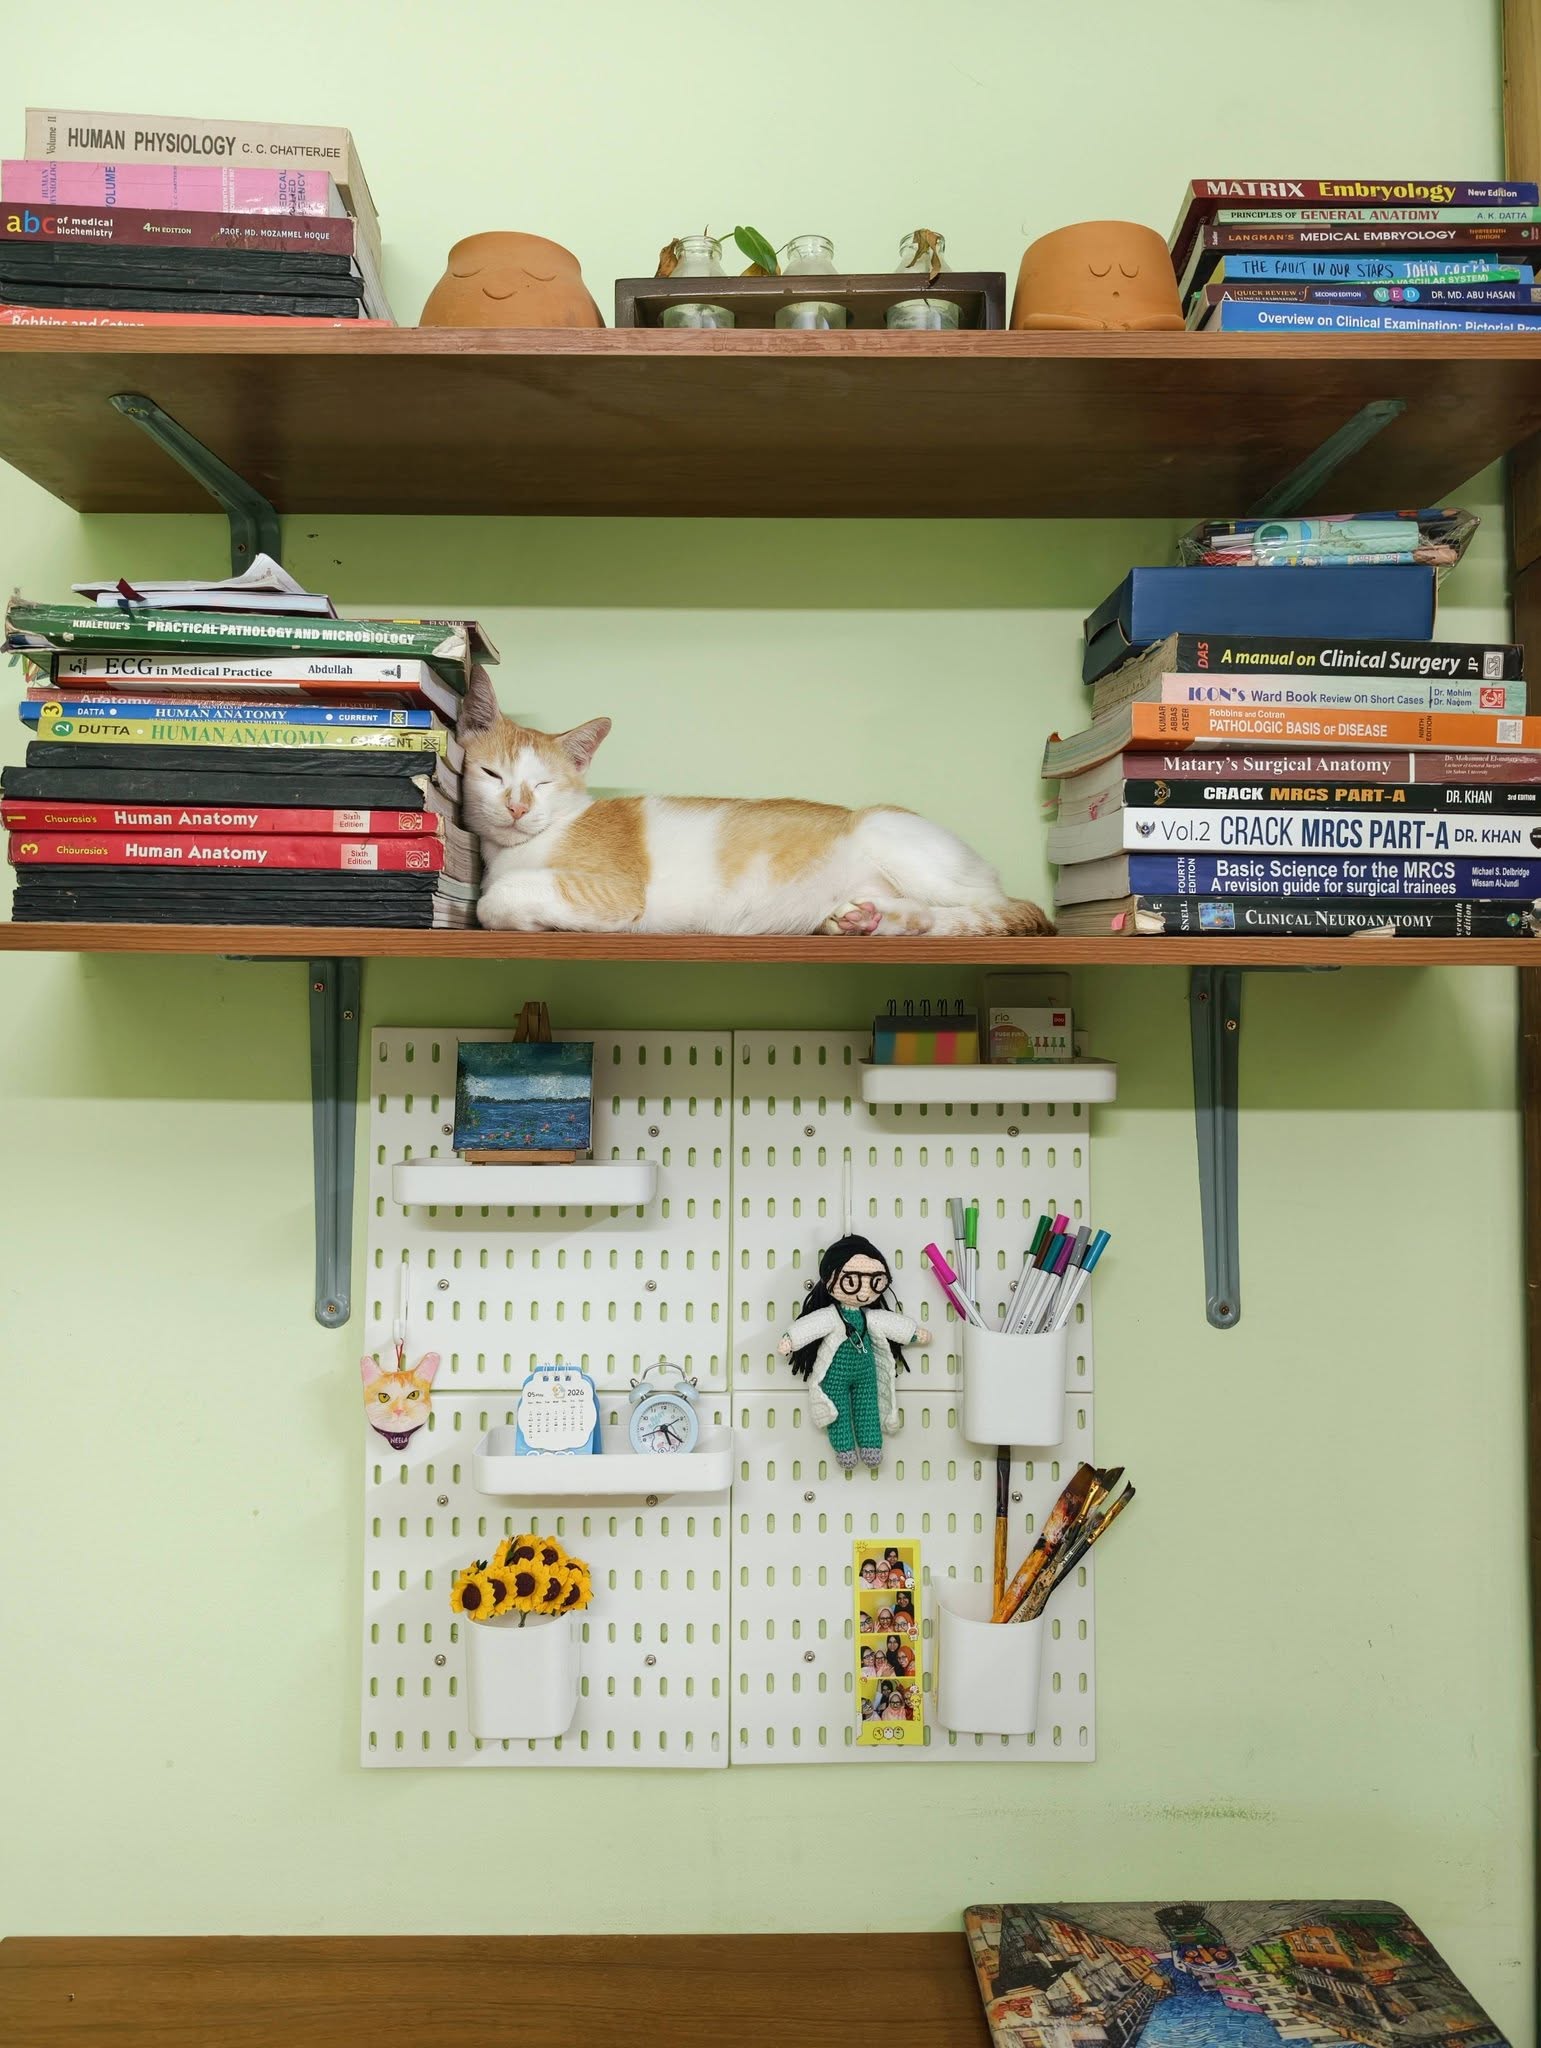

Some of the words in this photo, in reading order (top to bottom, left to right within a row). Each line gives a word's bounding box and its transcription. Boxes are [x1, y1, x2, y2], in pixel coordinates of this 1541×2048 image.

[46, 127, 57, 154] Volume
[68, 128, 126, 150] HUMAN
[134, 131, 236, 157] PHYSIOLOGY
[242, 144, 253, 154] C.
[256, 144, 267, 154] C.
[270, 146, 341, 158] CHATTERJEE
[1207, 181, 1305, 198] MATRIX
[1319, 182, 1456, 203] Embryology
[1468, 188, 1487, 197] New
[1488, 188, 1518, 198] Edition
[6, 210, 55, 234] abc
[57, 216, 69, 224] of
[72, 218, 114, 227] medical
[1301, 210, 1366, 220] GENERAL
[1370, 210, 1440, 220] ANATOMY
[1500, 212, 1528, 220] DATTA
[57, 226, 114, 239] biochemistry
[143, 222, 161, 232] 4TH
[162, 226, 192, 234] EDITION
[220, 227, 242, 236] PROF.
[260, 230, 302, 239] MOZAMMEL
[304, 231, 330, 240] HOQUE
[1300, 232, 1360, 241] MEDICAL
[1364, 230, 1457, 241] EMBRYOLOGY
[1243, 260, 1268, 274] THE
[1275, 261, 1307, 275] FAULT
[1313, 262, 1327, 276] IN
[1330, 264, 1351, 278] OUR
[1356, 263, 1395, 278] STARS
[1403, 262, 1439, 279] JOHN
[1448, 274, 1489, 283] SYSTEM)
[1431, 290, 1446, 299] DR.
[1448, 290, 1463, 299] MD.
[1466, 291, 1484, 299] ABU
[1486, 291, 1516, 300] HASAN
[1258, 312, 1314, 325] Overview
[1318, 316, 1332, 326] on
[1336, 316, 1380, 328] Clinical
[72, 620, 131, 631] KHALEQUE'S
[147, 620, 218, 634] PRACTICAL
[220, 624, 292, 638] PATHOLOGY
[294, 628, 320, 640] AND
[322, 630, 416, 645] MICROBIOLOGY
[1198, 642, 1209, 669] DAS
[1221, 649, 1232, 664] A
[1236, 651, 1295, 666] manual
[1296, 655, 1316, 666] on
[1319, 649, 1387, 669] Clinical
[1389, 652, 1461, 676] Surgery
[105, 658, 152, 675] ECG
[156, 667, 168, 676] in
[172, 668, 219, 677] Medical
[222, 668, 273, 678] Practice
[308, 664, 353, 675] Abdullah
[1188, 687, 1246, 702] ICON's
[1251, 690, 1282, 702] Ward
[1286, 692, 1317, 703] Book
[1320, 694, 1352, 704] Review
[1370, 695, 1396, 704] Short
[1397, 696, 1424, 705] Cases
[1434, 688, 1446, 697] Dr.
[1448, 688, 1472, 698] Mohim
[1434, 698, 1446, 706] Dr.
[78, 708, 105, 716] DATTA
[155, 708, 210, 718] HUMAN
[214, 710, 288, 720] ANATOMY
[1158, 706, 1166, 732] KUMAR
[1170, 706, 1178, 732] ABBAS
[1182, 708, 1190, 732] ASTER
[1209, 708, 1243, 718] Robbins
[1258, 710, 1286, 719] Cotran
[78, 724, 130, 736] DUTTA
[152, 725, 225, 741] HUMAN
[230, 728, 329, 746] ANATOMY
[1210, 719, 1283, 734] PATHOLOGIC
[1286, 722, 1321, 736] BASIS
[1323, 727, 1336, 736] OF
[1338, 723, 1388, 738] DISEASE
[1163, 756, 1238, 775] Matary's
[1243, 756, 1312, 775] Surgical
[1316, 758, 1392, 776] Anatomy
[1204, 786, 1264, 800] CRACK
[1270, 788, 1329, 801] MRCS
[1334, 788, 1406, 802] PART-A
[1446, 790, 1462, 804] DR.
[1464, 790, 1493, 804] KHAN
[44, 814, 97, 824] Chaurasia's
[114, 811, 173, 825] Human
[178, 812, 258, 828] Anatomy
[343, 813, 361, 821] Sixth
[1161, 820, 1210, 841] Vol.2
[1220, 816, 1294, 846] CRACK
[1302, 818, 1363, 848] MRCS
[1370, 820, 1450, 850] PART-A
[1454, 828, 1478, 842] DR.
[1482, 830, 1522, 844] KHAN
[56, 846, 108, 856] Chaurasia's
[126, 844, 183, 859] Human
[188, 846, 268, 864] Anatomy
[348, 858, 372, 866] Edition
[351, 850, 368, 858] Sixth
[1178, 856, 1186, 894] FOURTH
[1188, 858, 1196, 894] EDITION
[1216, 860, 1260, 878] Basic
[1270, 860, 1338, 878] Science
[1342, 860, 1367, 878] for
[1371, 861, 1398, 878] the
[1404, 862, 1456, 879] MRCS
[1472, 866, 1494, 876] Michael
[1495, 868, 1502, 876] S.
[1502, 868, 1530, 878] Delbridge
[1210, 878, 1222, 892] A
[1224, 878, 1279, 894] revision
[1283, 879, 1320, 896] guide
[1324, 879, 1342, 894] for
[1346, 880, 1400, 896] surgical
[1403, 880, 1457, 895] trainees
[1472, 878, 1494, 888] Wissam
[1494, 879, 1520, 888] Al-Jundi
[1180, 900, 1190, 931] SNELL
[1245, 910, 1312, 926] CLINICAL
[1315, 910, 1434, 928] NEUROANATOMY
[1463, 904, 1472, 936] edition
